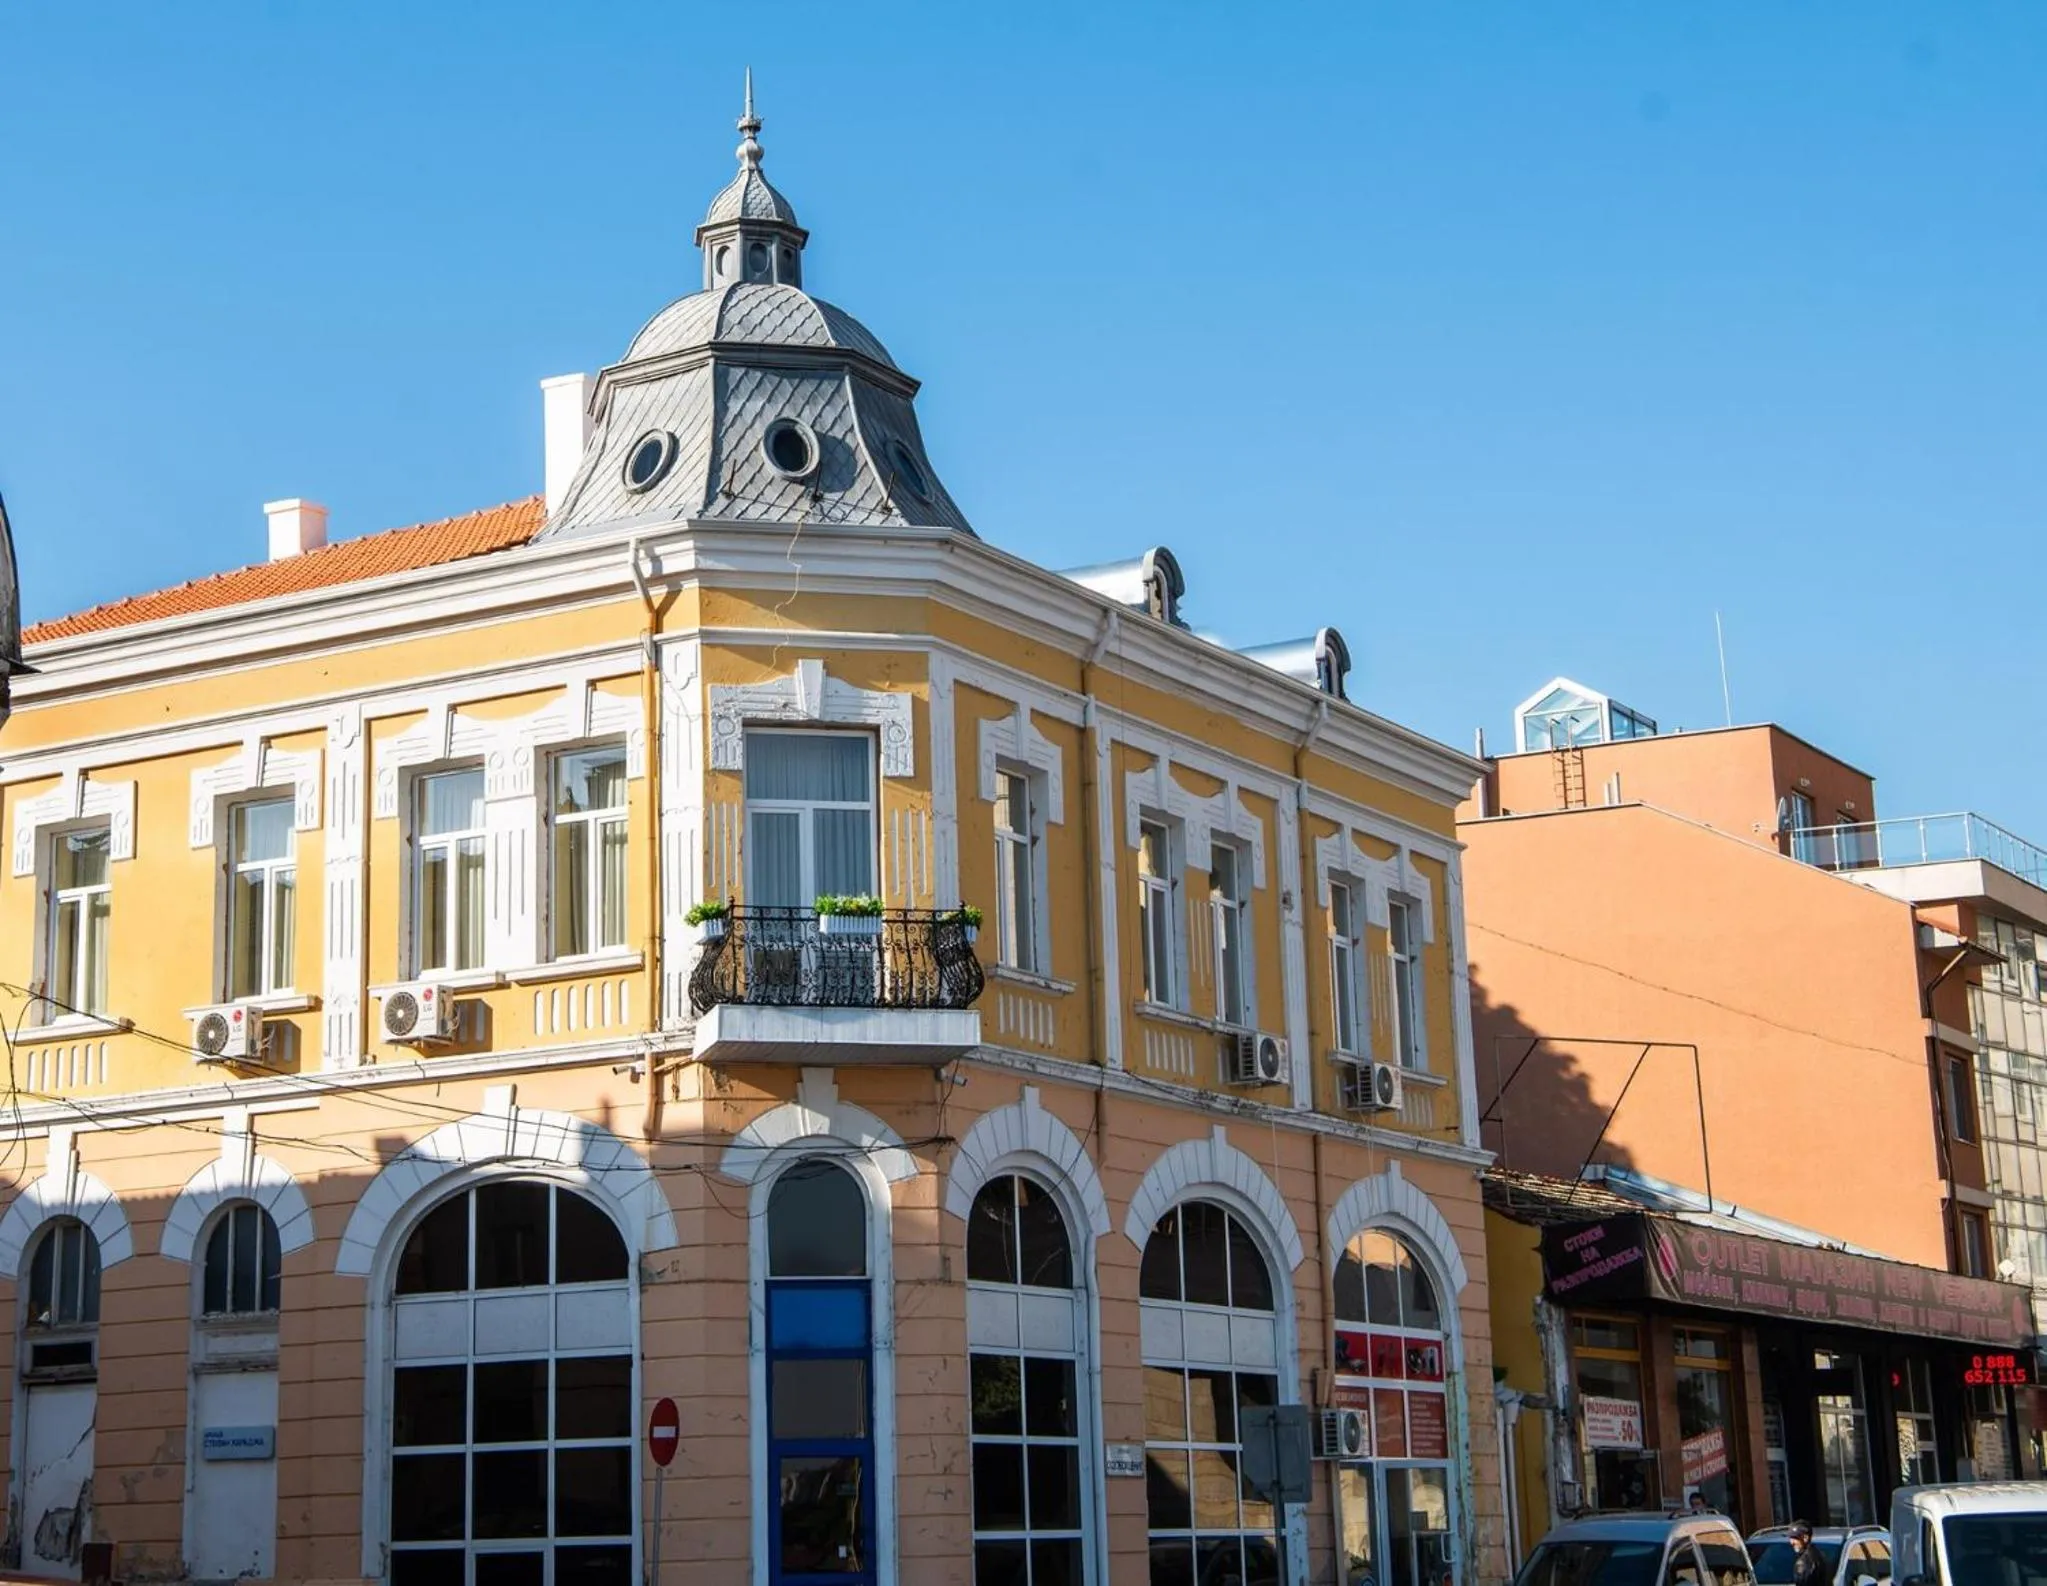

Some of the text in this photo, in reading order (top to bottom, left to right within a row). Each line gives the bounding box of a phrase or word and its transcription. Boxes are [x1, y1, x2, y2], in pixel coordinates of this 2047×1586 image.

[1691, 1231, 1769, 1275] OUTLET
[1884, 1264, 1922, 1301] NEW
[1972, 1355, 1982, 1369] 0
[1965, 1368, 2026, 1383] 652 115
